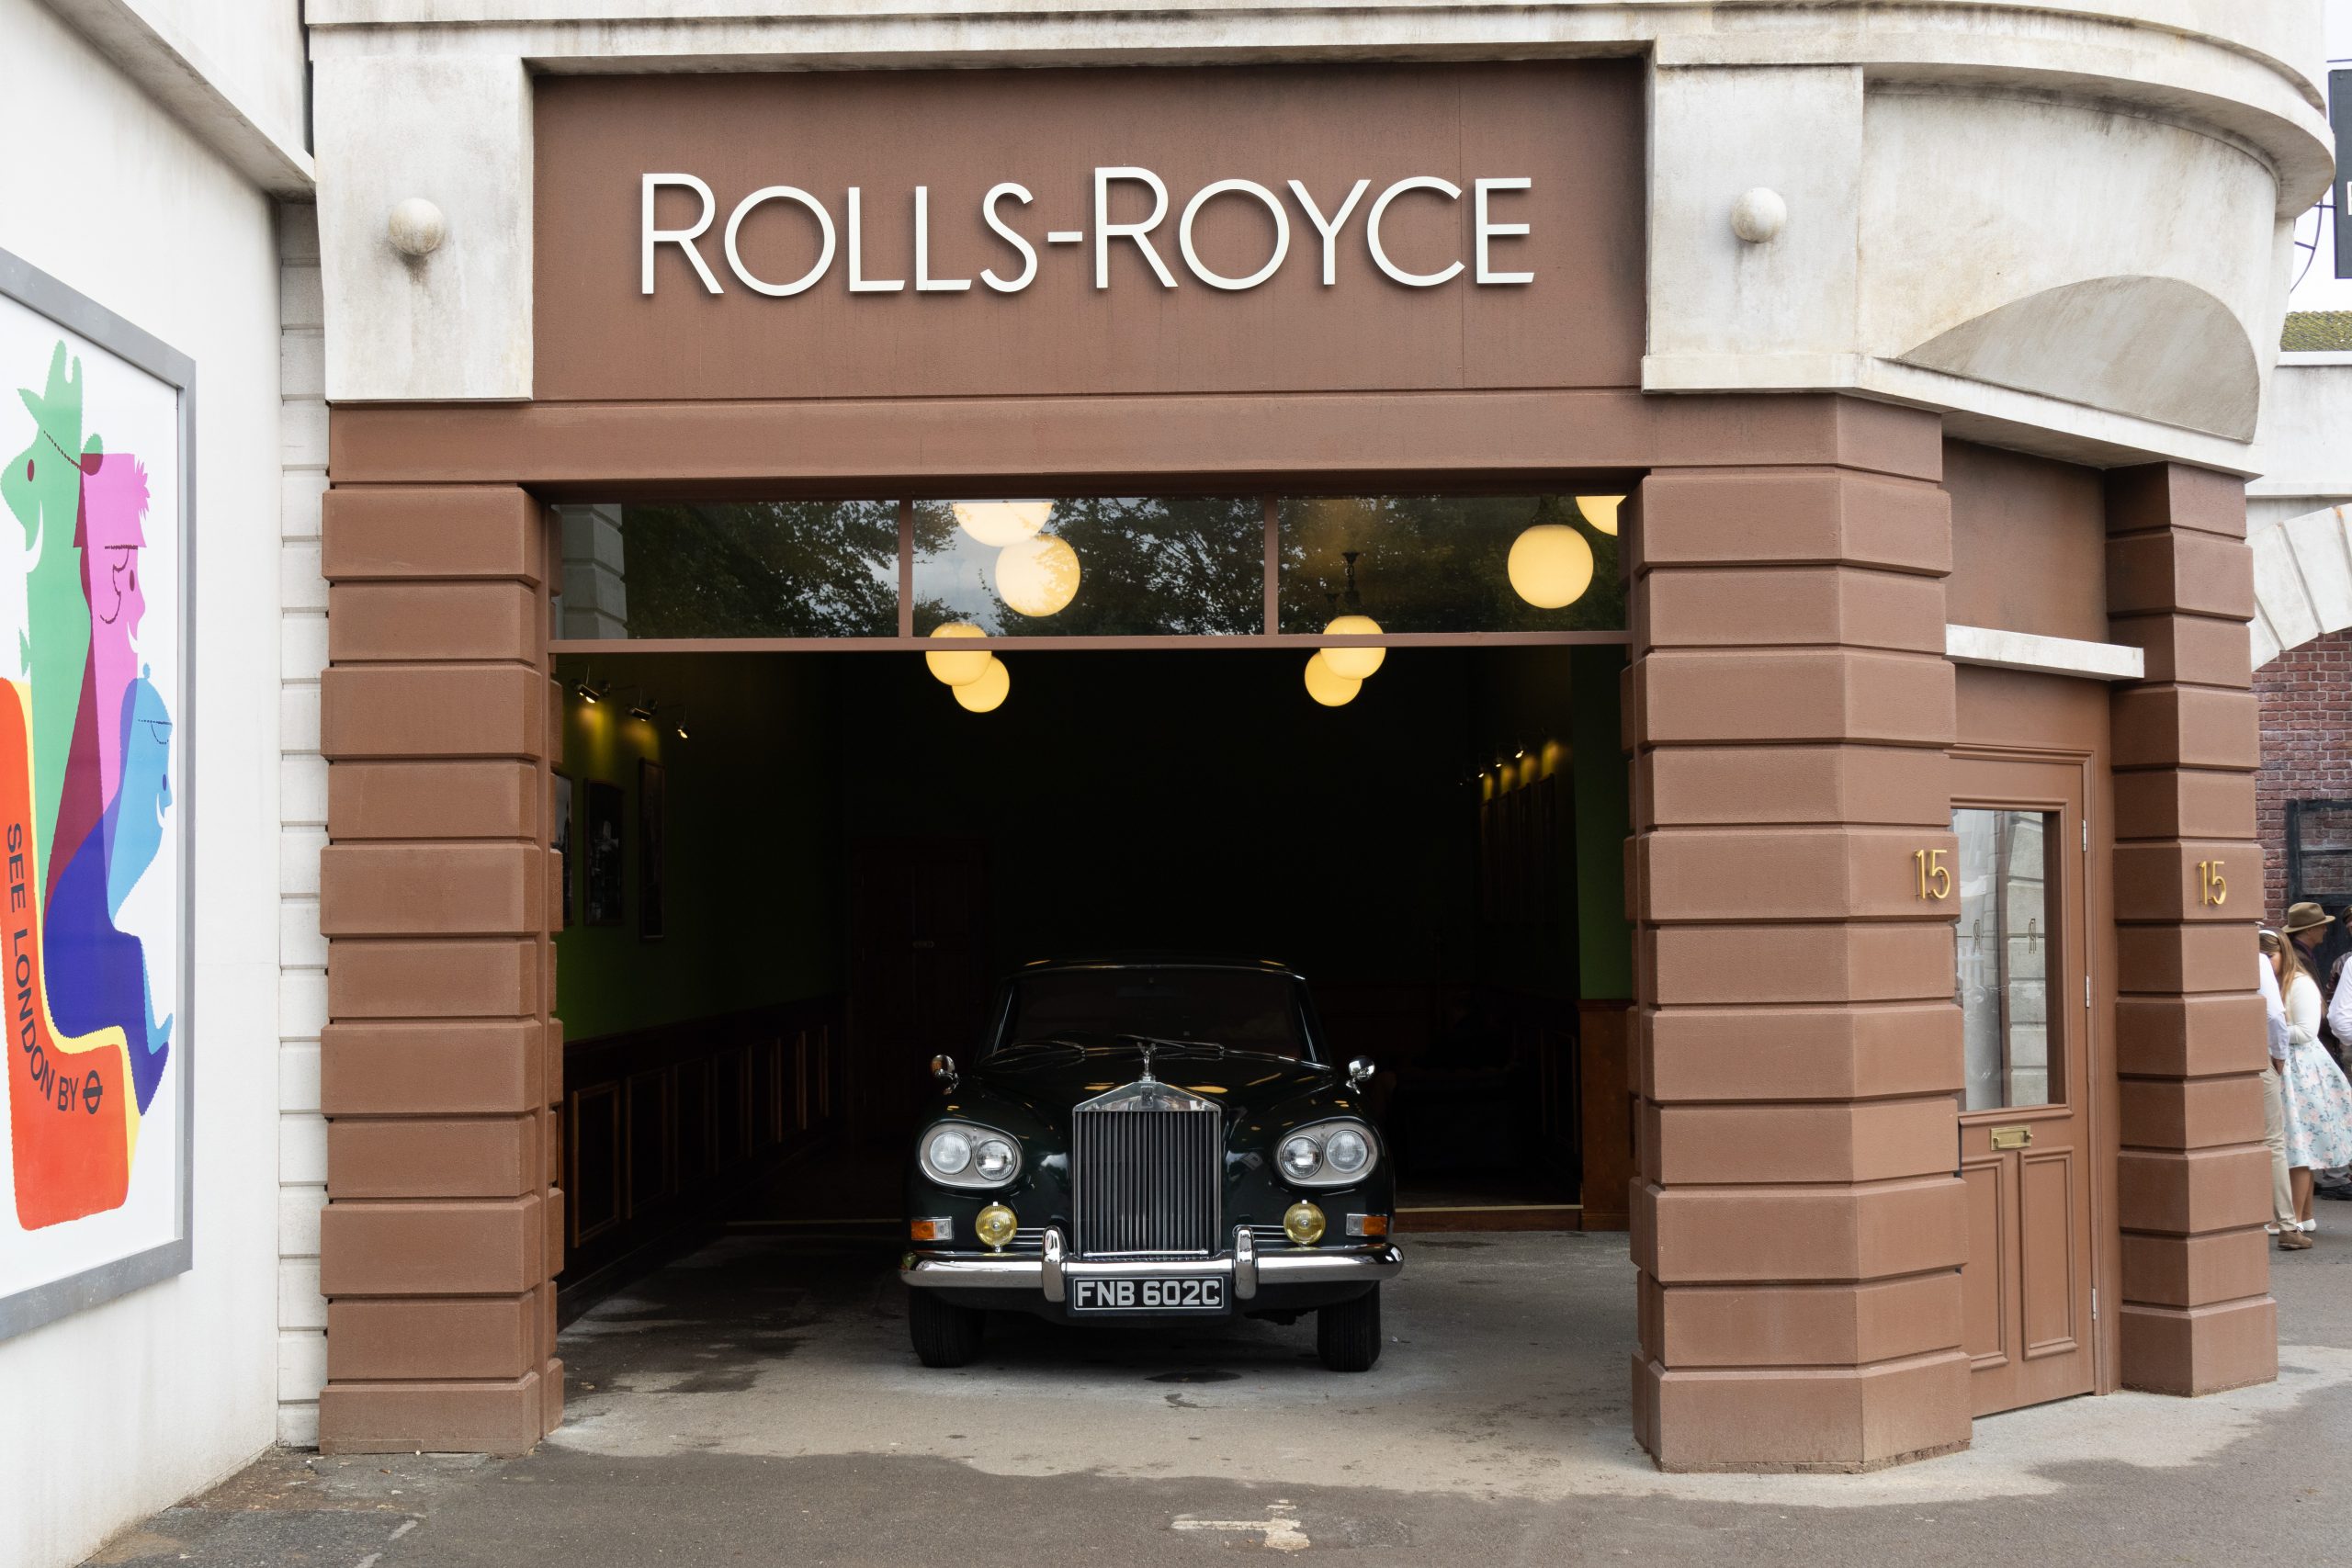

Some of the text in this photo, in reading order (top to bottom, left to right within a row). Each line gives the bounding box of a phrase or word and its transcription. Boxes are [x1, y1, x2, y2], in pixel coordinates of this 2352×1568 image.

[640, 166, 1535, 297] ROLLS-ROYCE
[1915, 850, 1951, 899] 15
[2199, 861, 2226, 905] 15
[7, 823, 79, 1111] SEE LONDON BY
[1078, 1280, 1220, 1306] FNB 602C
